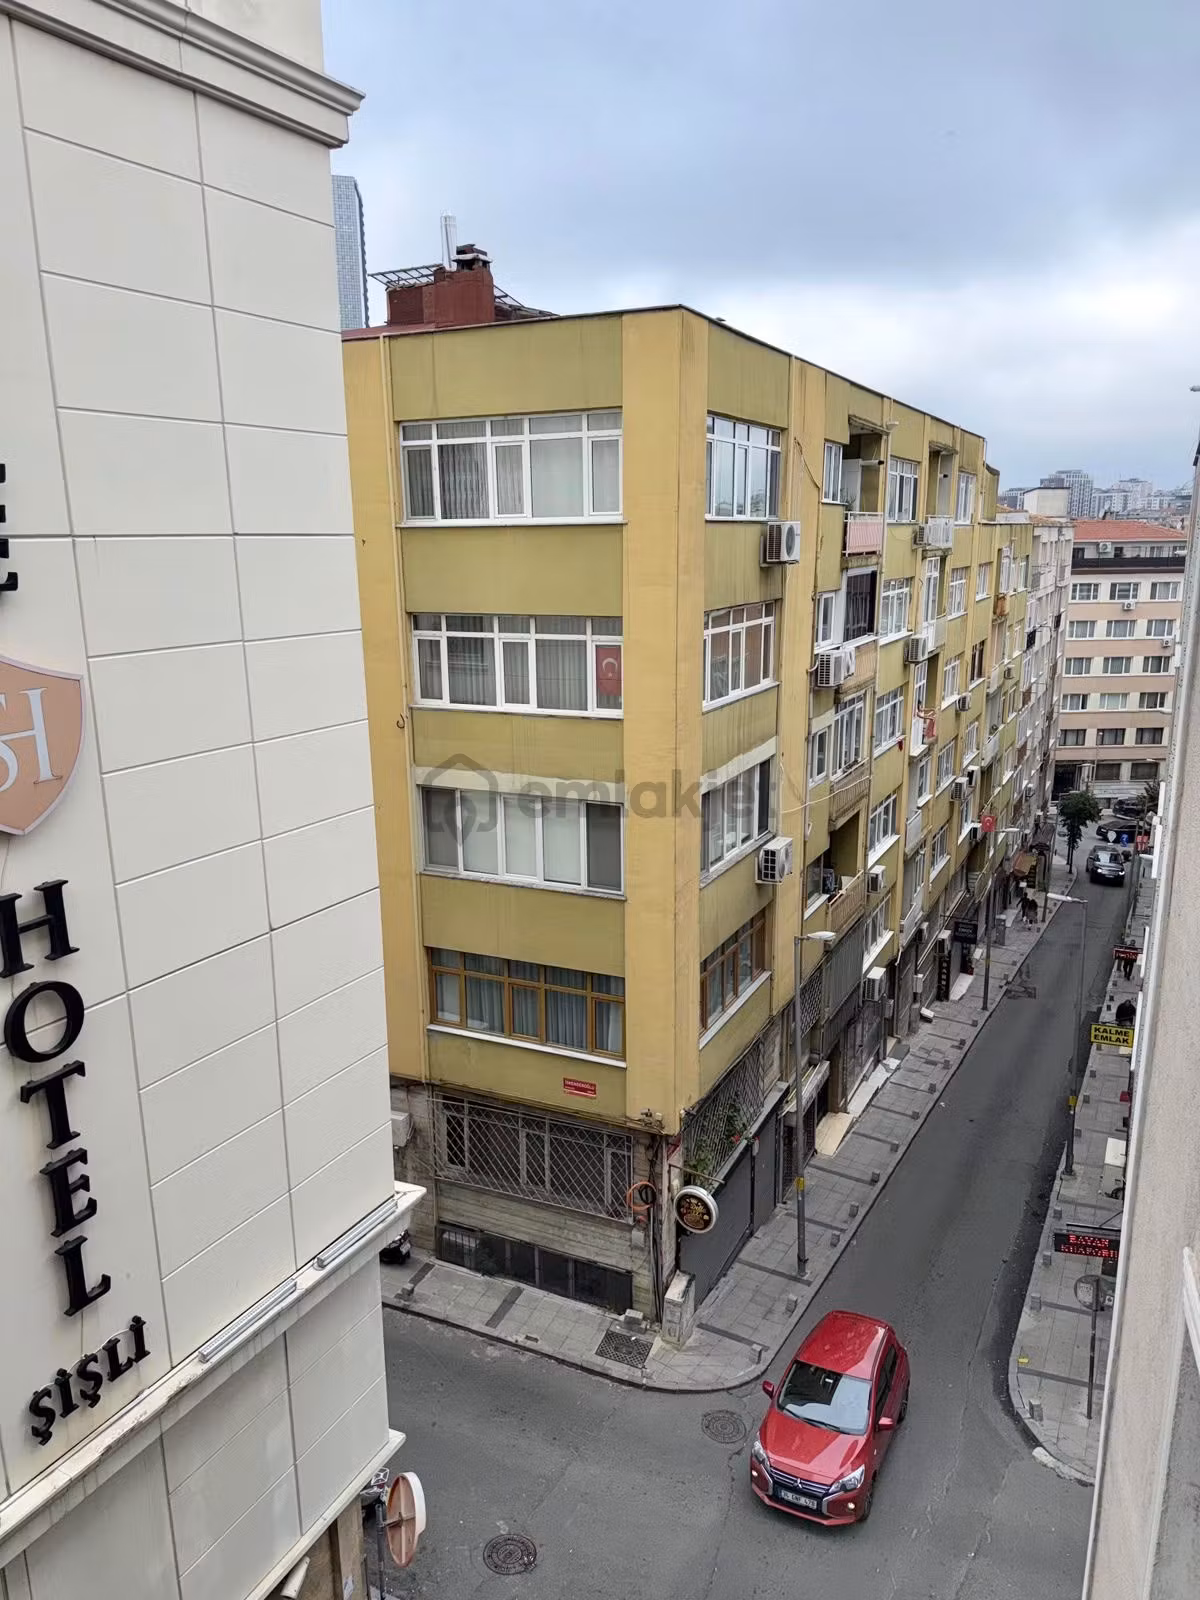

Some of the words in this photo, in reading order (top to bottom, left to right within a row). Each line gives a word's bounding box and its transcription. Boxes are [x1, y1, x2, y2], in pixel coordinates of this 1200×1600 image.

[1093, 1026, 1130, 1037] KALME
[1093, 1034, 1129, 1044] EMLAK
[0, 879, 111, 1317] HOTEL
[29, 1315, 151, 1446] ŞİŞLİ
